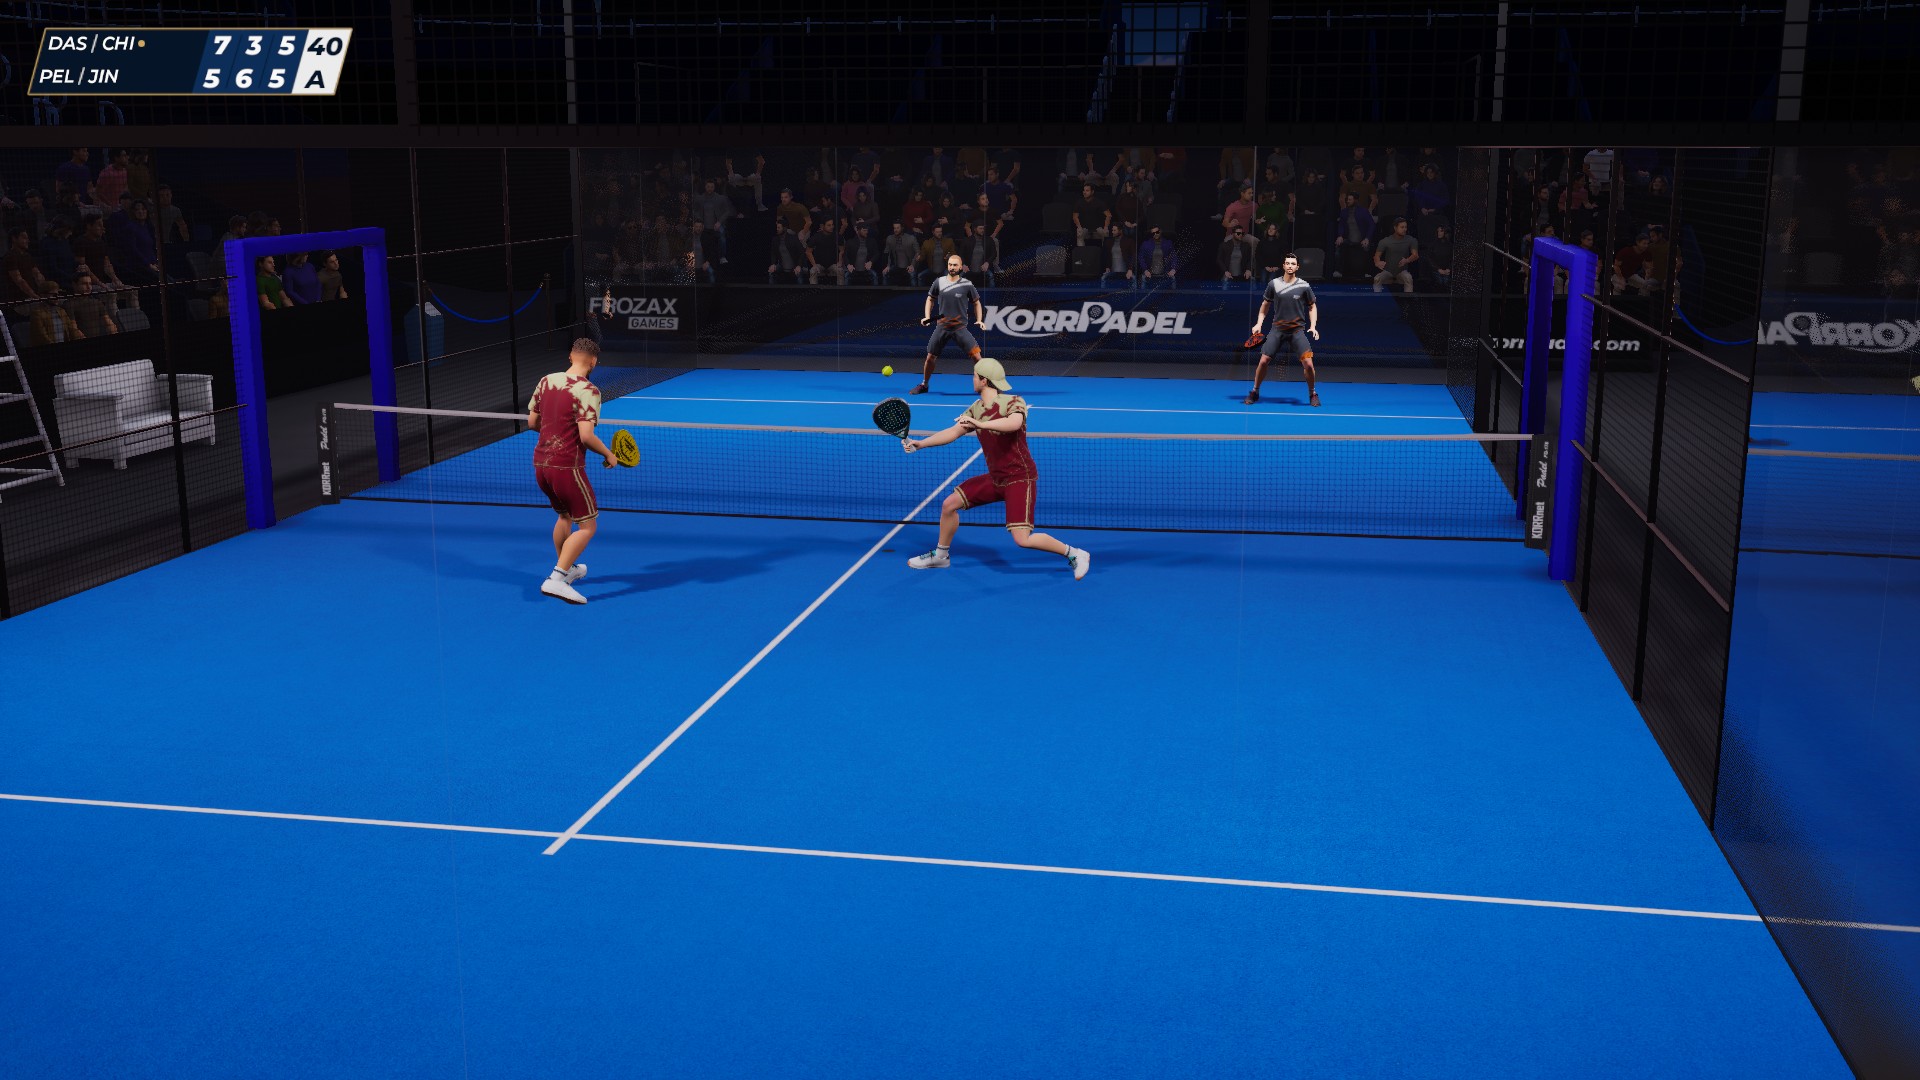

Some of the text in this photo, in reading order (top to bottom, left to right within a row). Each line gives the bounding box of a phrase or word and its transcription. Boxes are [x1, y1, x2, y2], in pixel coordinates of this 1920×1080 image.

[588, 297, 678, 315] FROZAX
[631, 318, 675, 329] GAMES
[1536, 460, 1548, 488] Padel
[1531, 501, 1545, 539] KORRnet
